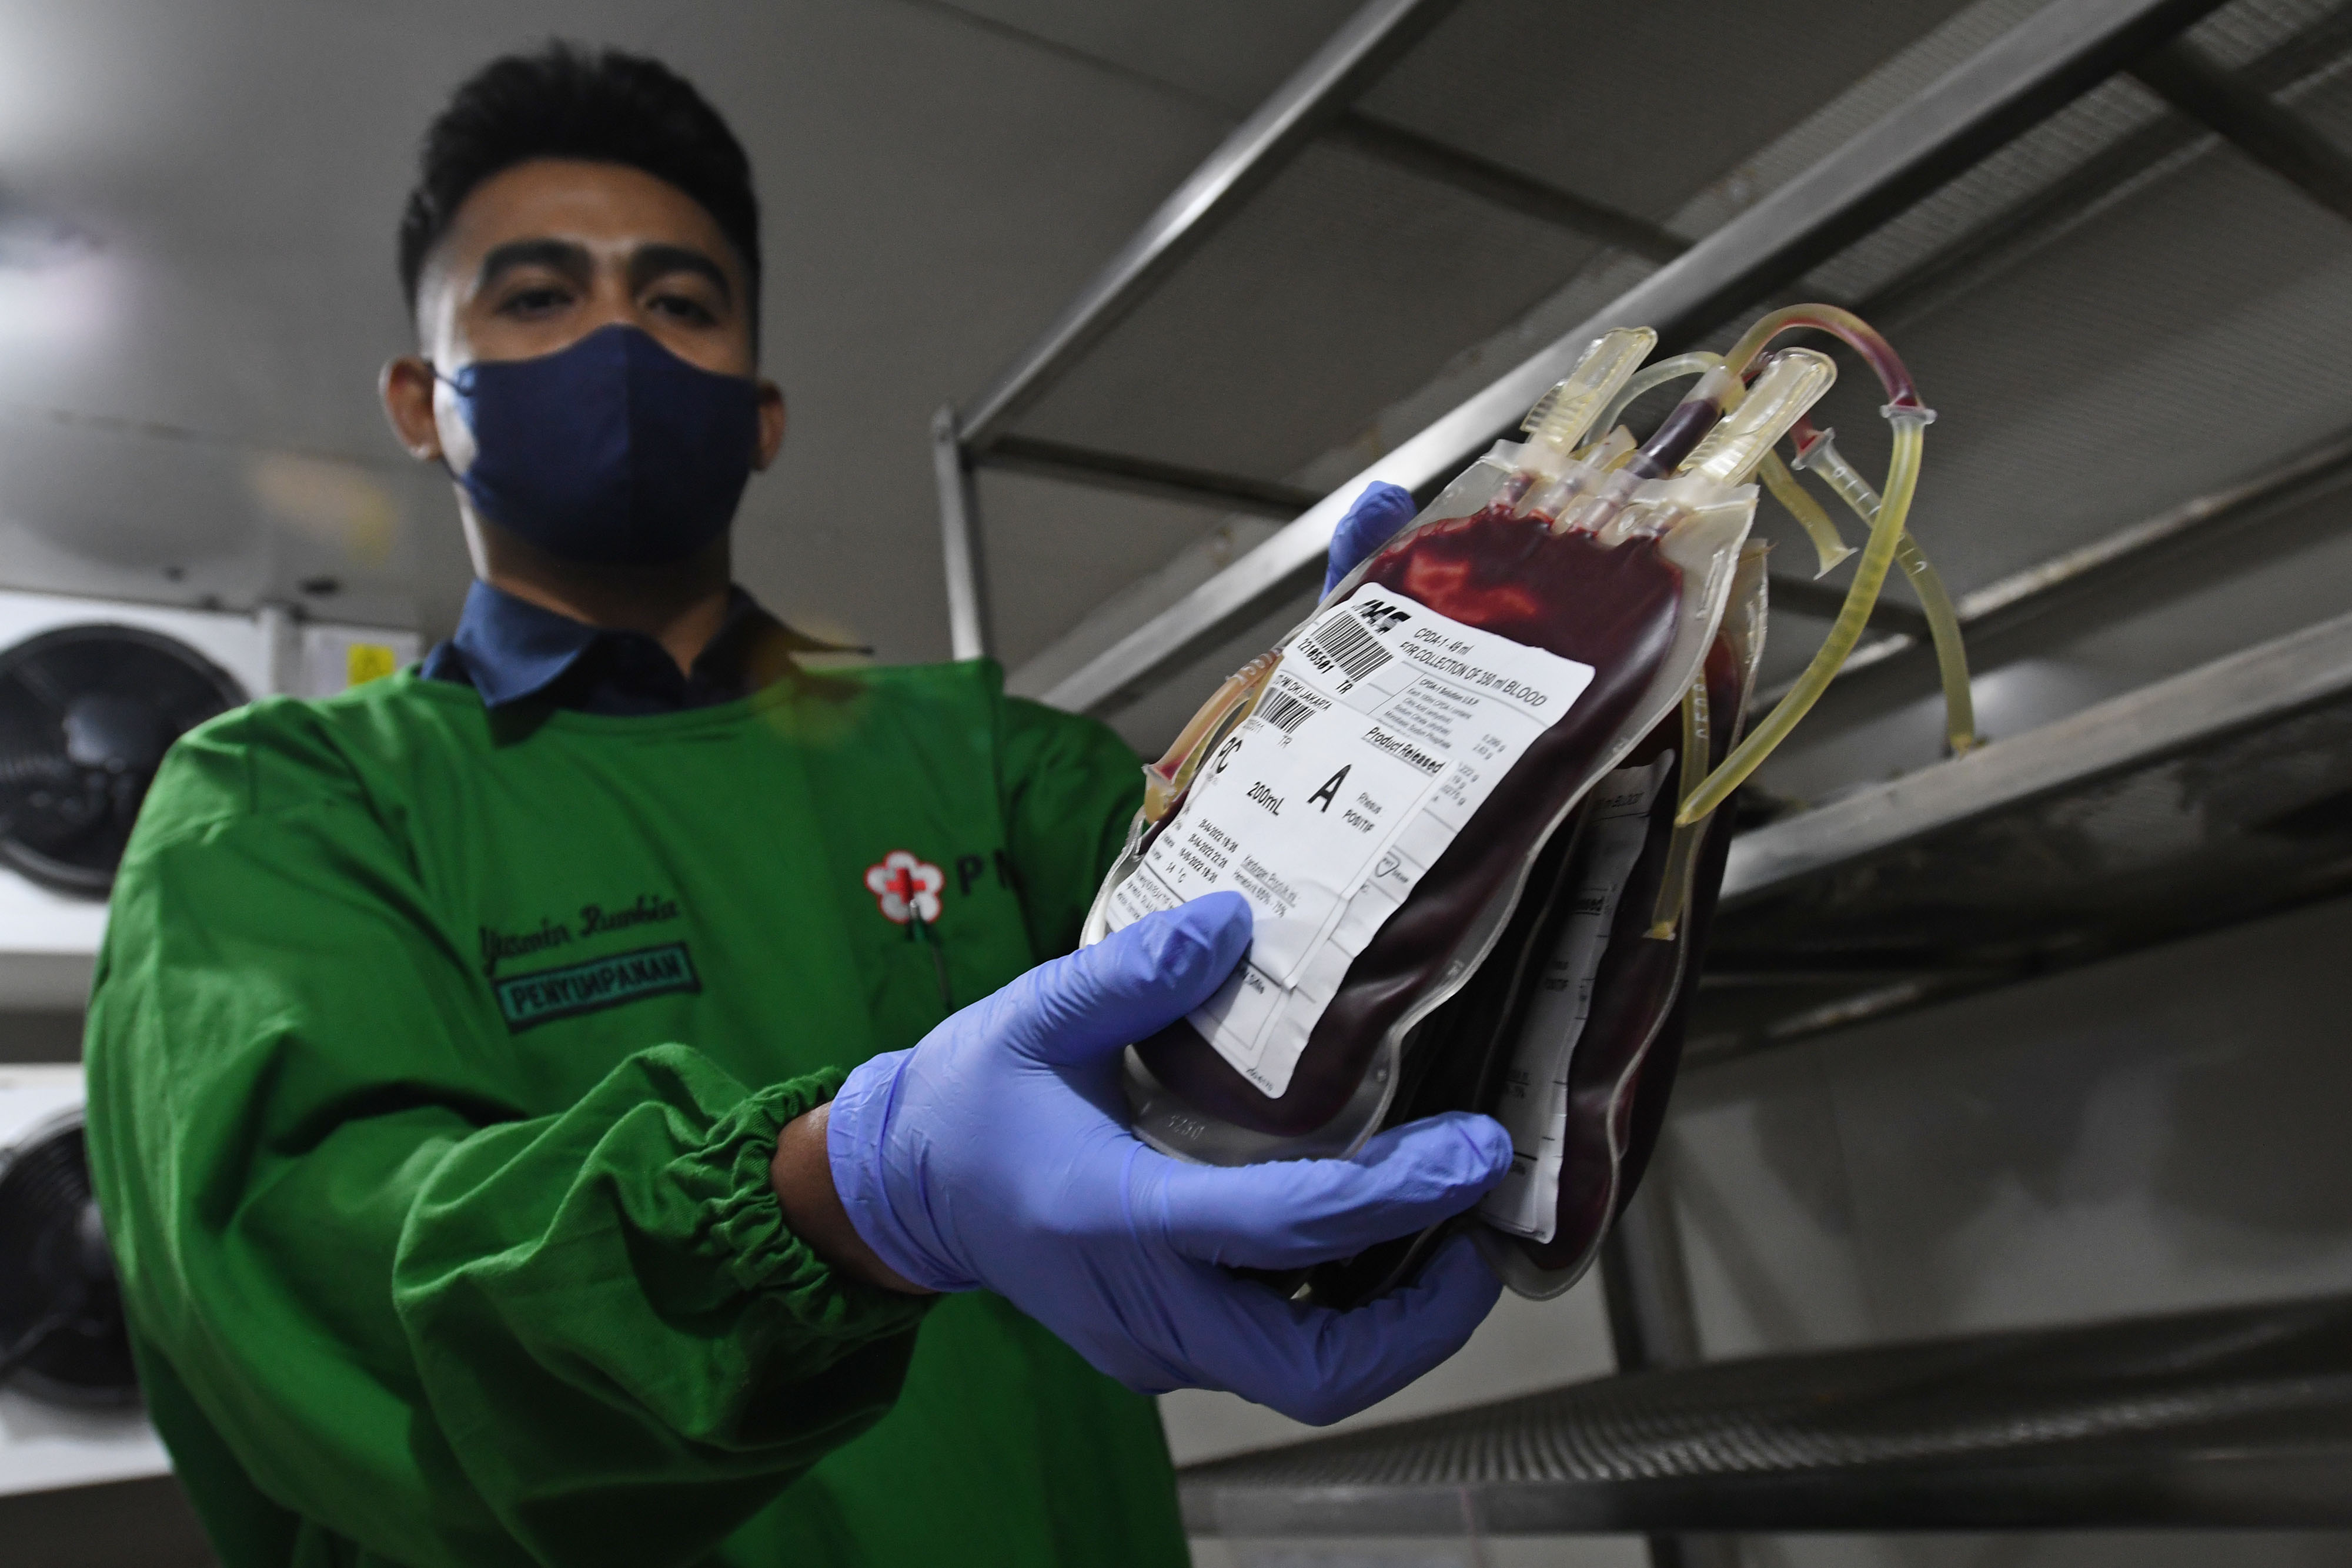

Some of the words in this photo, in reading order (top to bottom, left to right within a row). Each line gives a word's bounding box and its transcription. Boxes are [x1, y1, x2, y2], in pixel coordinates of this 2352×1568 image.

[1414, 627, 1449, 647] CPDA-1
[1335, 680, 1354, 695] TR
[1415, 651, 1465, 676] COLLECTION
[1464, 668, 1479, 680] OF
[1504, 680, 1548, 707] BLOOD
[1288, 682, 1305, 695] DKI
[1298, 690, 1332, 711] JAKARTA
[1277, 735, 1293, 749] TR
[1364, 726, 1402, 753] Product
[1400, 744, 1446, 774] Released
[1246, 781, 1285, 816] 200mL
[1307, 764, 1352, 813] A
[1342, 808, 1375, 834] POSITIF
